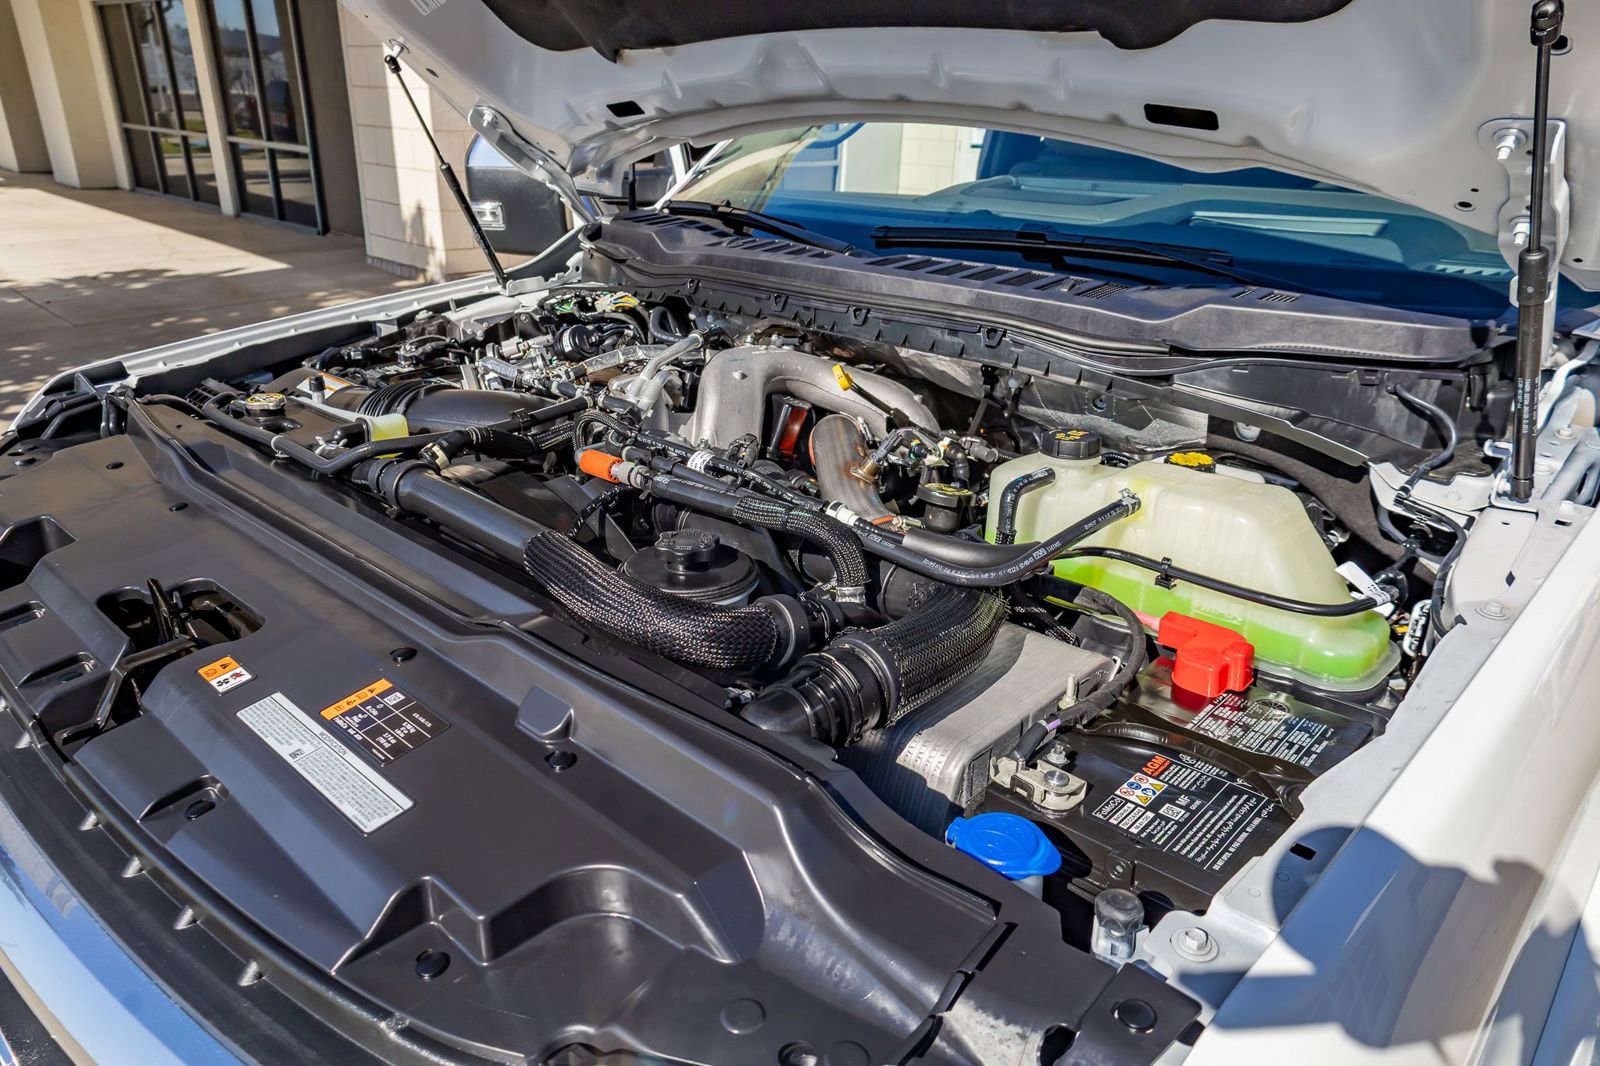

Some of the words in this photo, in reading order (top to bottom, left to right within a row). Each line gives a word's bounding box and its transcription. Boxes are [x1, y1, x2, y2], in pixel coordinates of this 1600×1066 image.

[319, 731, 346, 756] MODIFICATION
[1142, 754, 1167, 776] AGM
[1097, 798, 1121, 819] FoMoCo
[1175, 794, 1191, 807] MF
